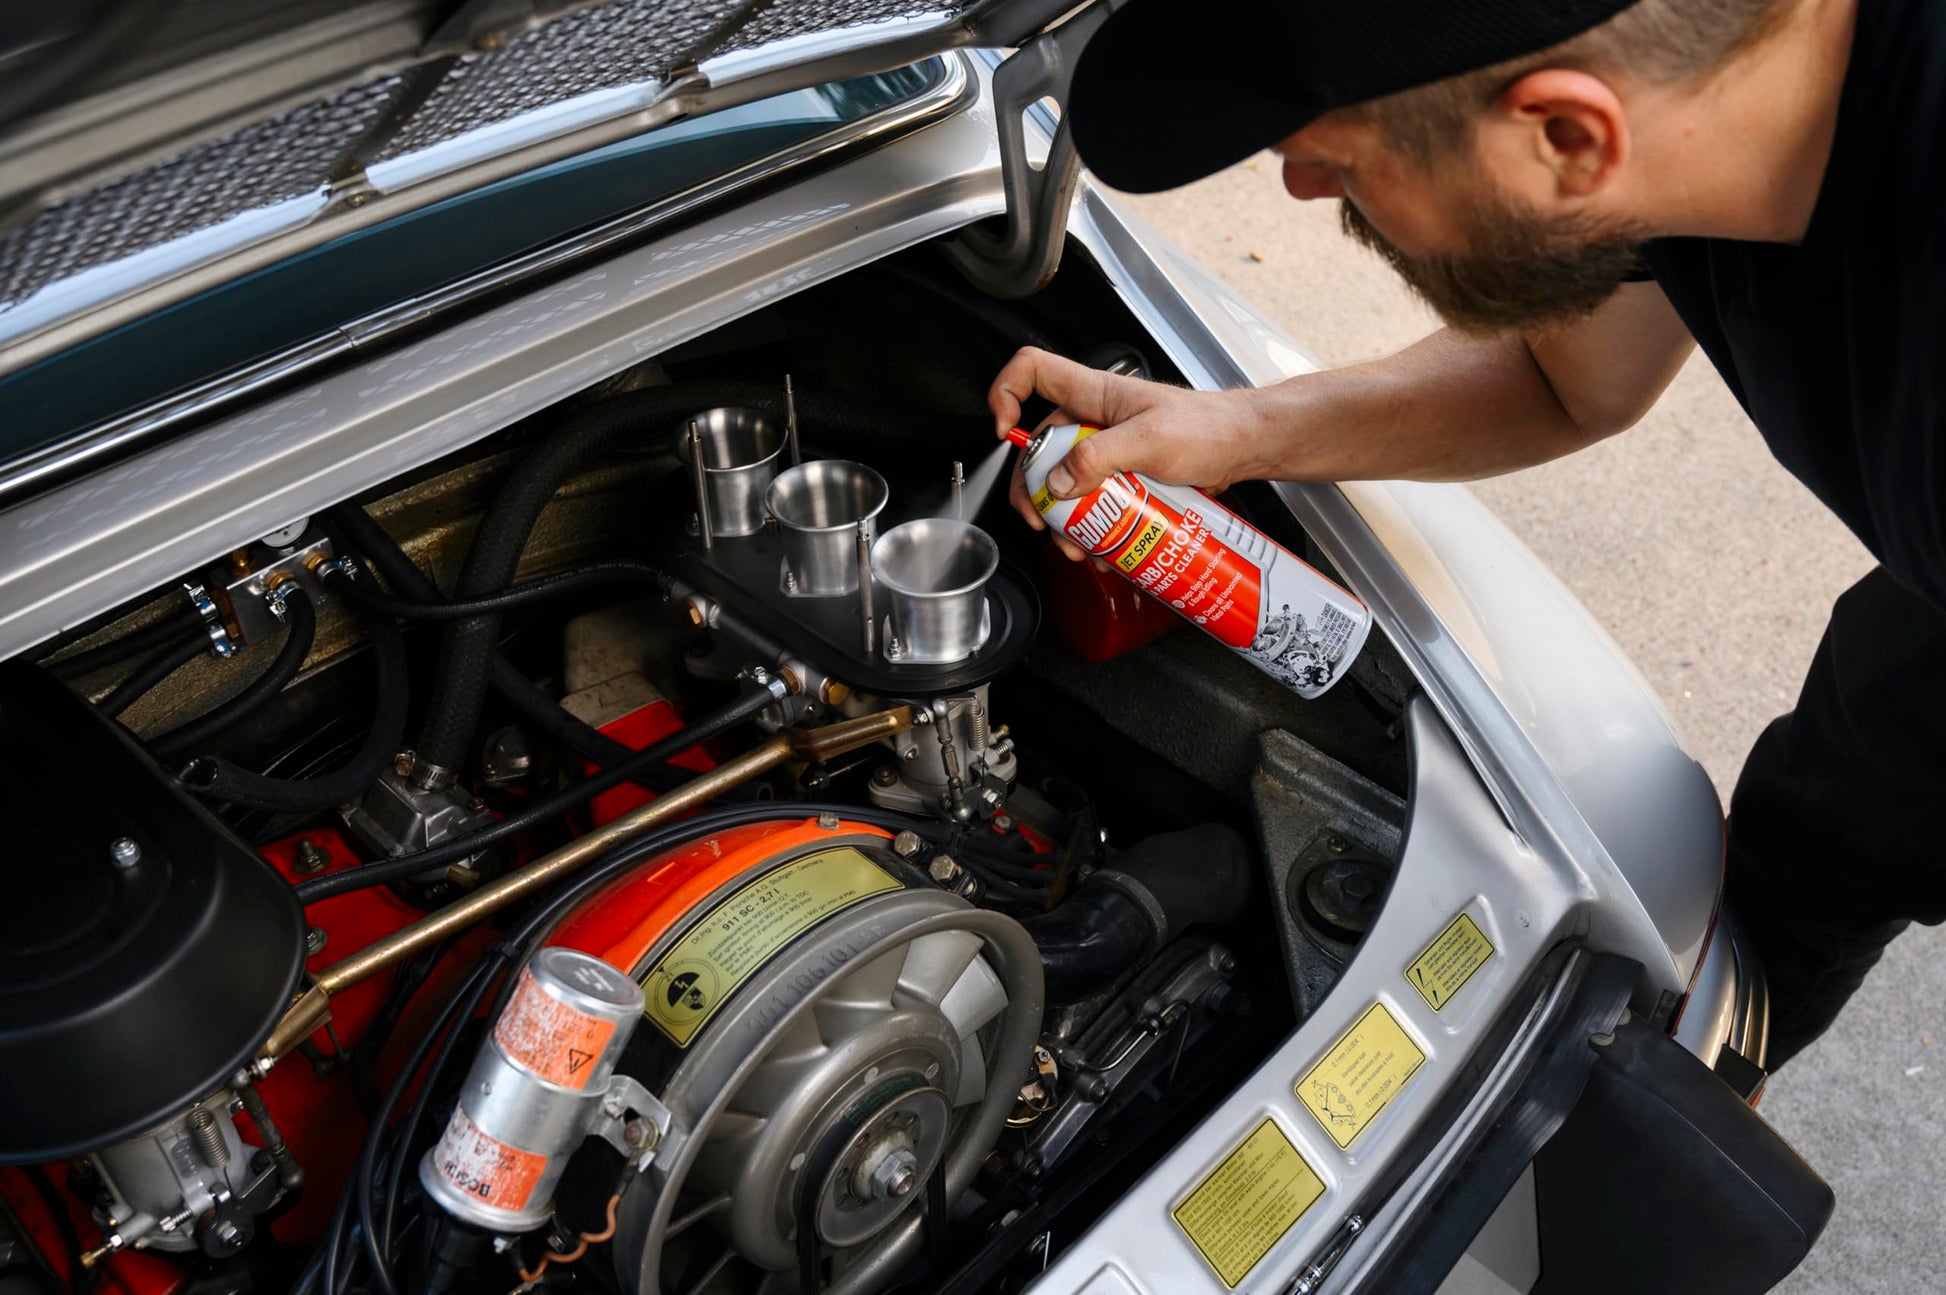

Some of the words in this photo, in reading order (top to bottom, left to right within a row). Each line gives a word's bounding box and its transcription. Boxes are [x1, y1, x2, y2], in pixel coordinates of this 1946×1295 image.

[1066, 468, 1137, 551] GUMOUT
[1120, 551, 1138, 570] JET
[1131, 517, 1165, 557] SPRAY
[1153, 570, 1179, 594] PARTS
[1172, 526, 1211, 575] CLEANER
[1178, 587, 1194, 604] Helps
[1188, 577, 1204, 593] Stop
[1197, 565, 1213, 582] Hard
[1190, 588, 1207, 606] Rough
[1201, 575, 1219, 594] Idling
[1201, 600, 1219, 618] Cleans
[1214, 595, 1224, 606] all
[1219, 570, 1244, 600] Unpainted
[1208, 607, 1224, 623] Metal
[1219, 596, 1234, 613] Parts
[729, 891, 755, 911] Porsche
[768, 869, 794, 887] Stuttgart
[796, 856, 824, 872] Germany
[795, 889, 810, 900] TDC
[721, 914, 740, 932] 911
[738, 902, 755, 919] SC
[758, 889, 775, 904] 2,7
[784, 959, 828, 1001] 106
